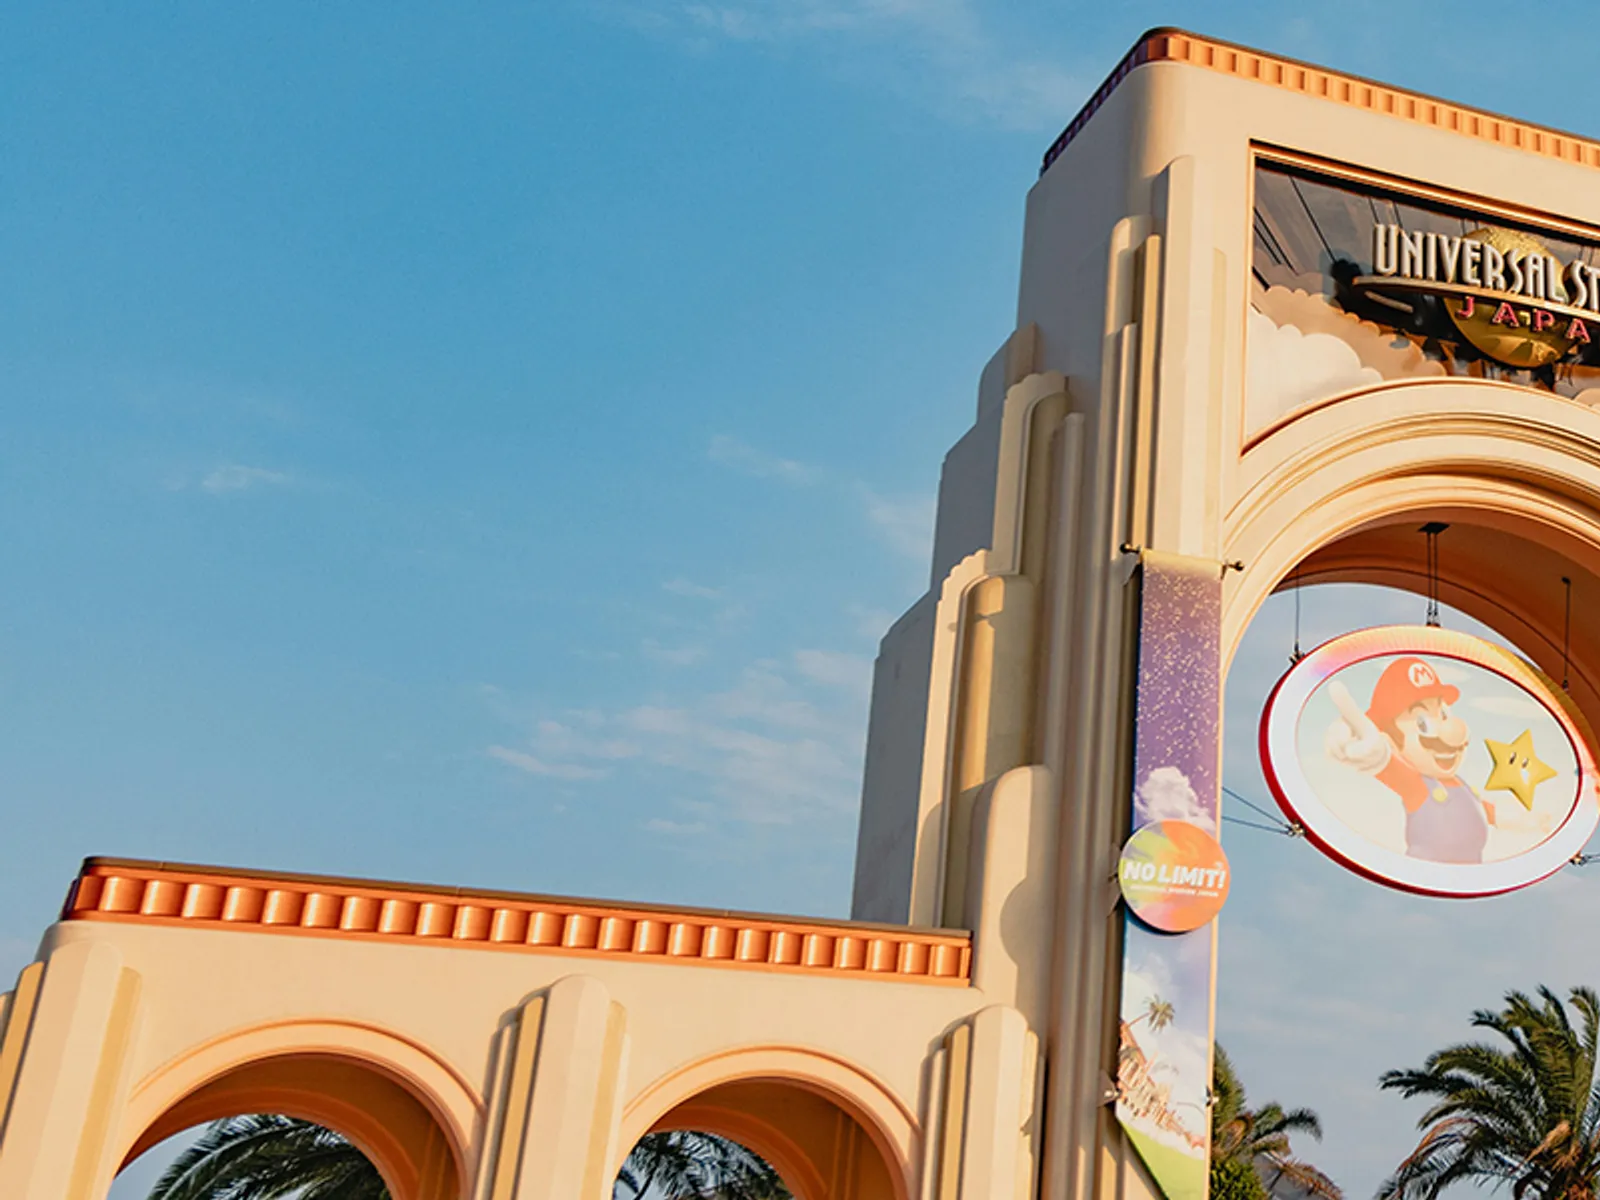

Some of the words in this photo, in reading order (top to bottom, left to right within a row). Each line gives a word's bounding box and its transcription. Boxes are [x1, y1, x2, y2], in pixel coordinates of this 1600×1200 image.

[1373, 223, 1569, 305] UNIVERSAL
[1123, 861, 1156, 882] NO
[1157, 863, 1226, 889] LIMIT!
